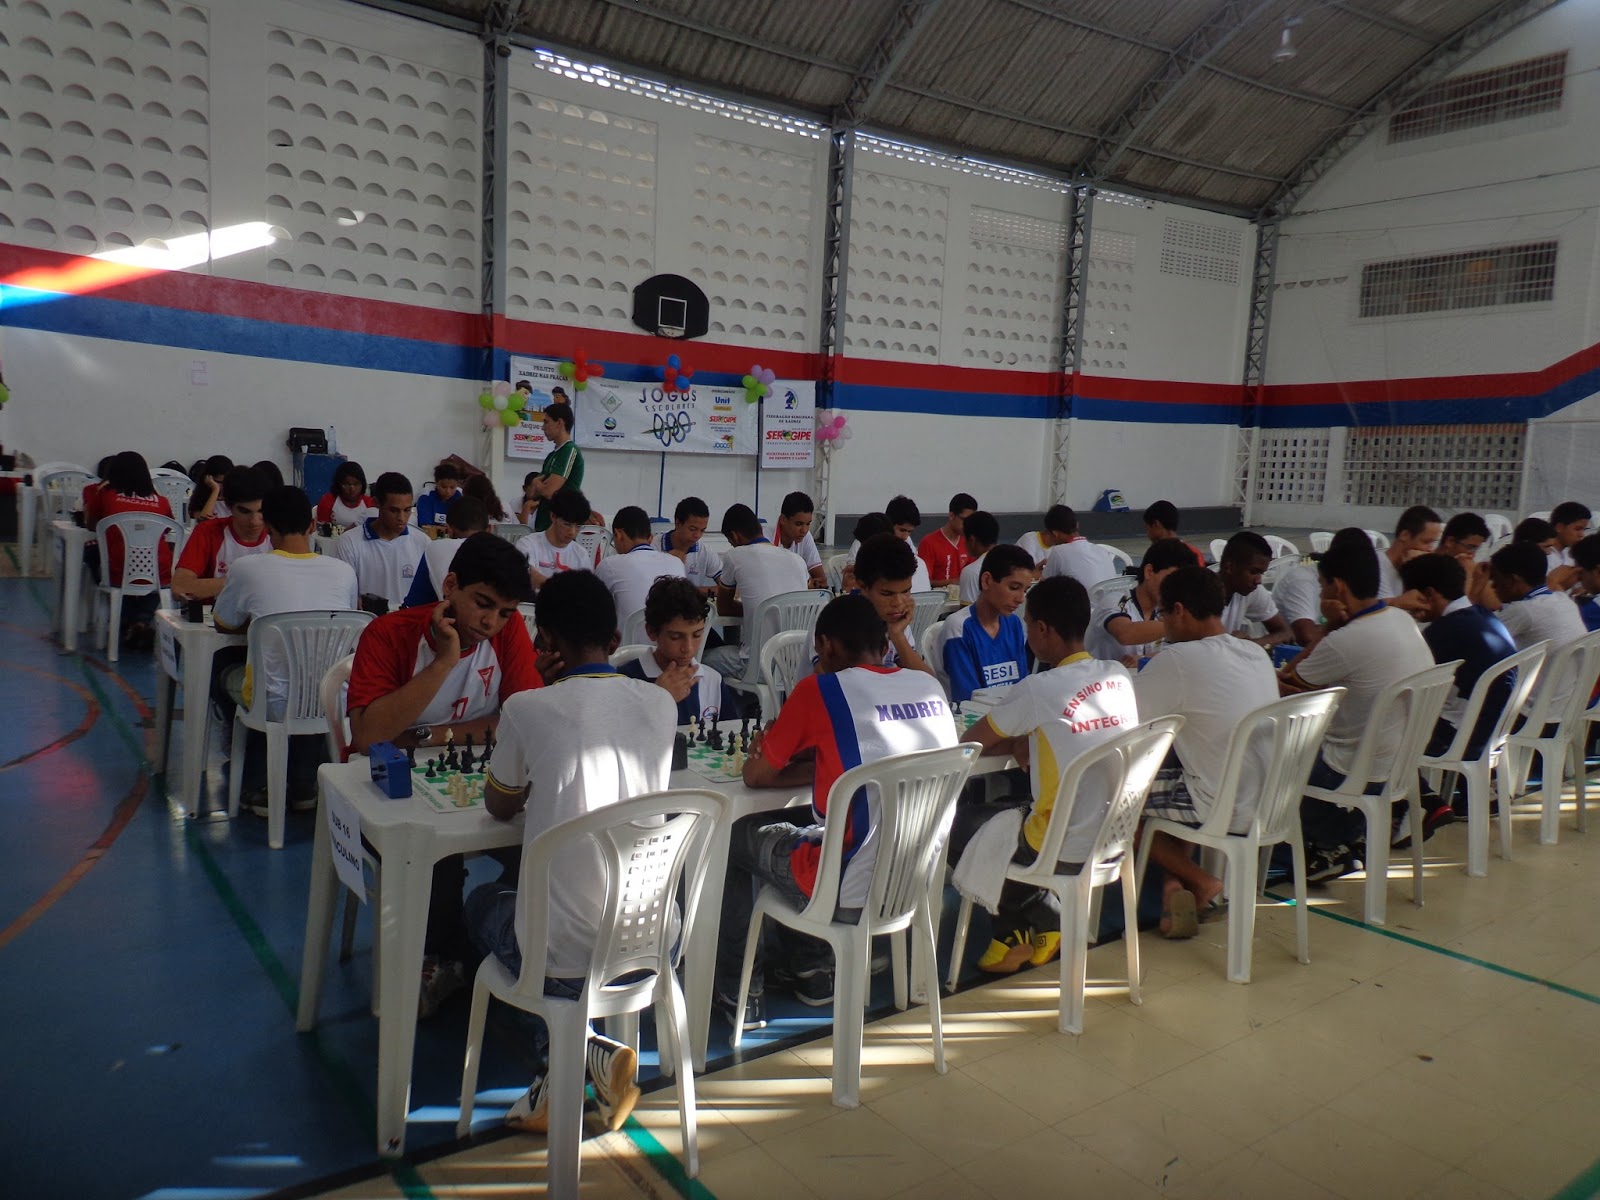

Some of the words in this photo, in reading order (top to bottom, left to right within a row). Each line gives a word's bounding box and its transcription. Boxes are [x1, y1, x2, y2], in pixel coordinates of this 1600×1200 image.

[639, 387, 697, 404] JOGOS
[715, 396, 731, 404] Unit
[645, 403, 695, 412] ESCOLARES
[766, 429, 811, 441] SERGIPE
[116, 497, 160, 508] ARACAJU-SE
[1062, 681, 1103, 719] ENSINO
